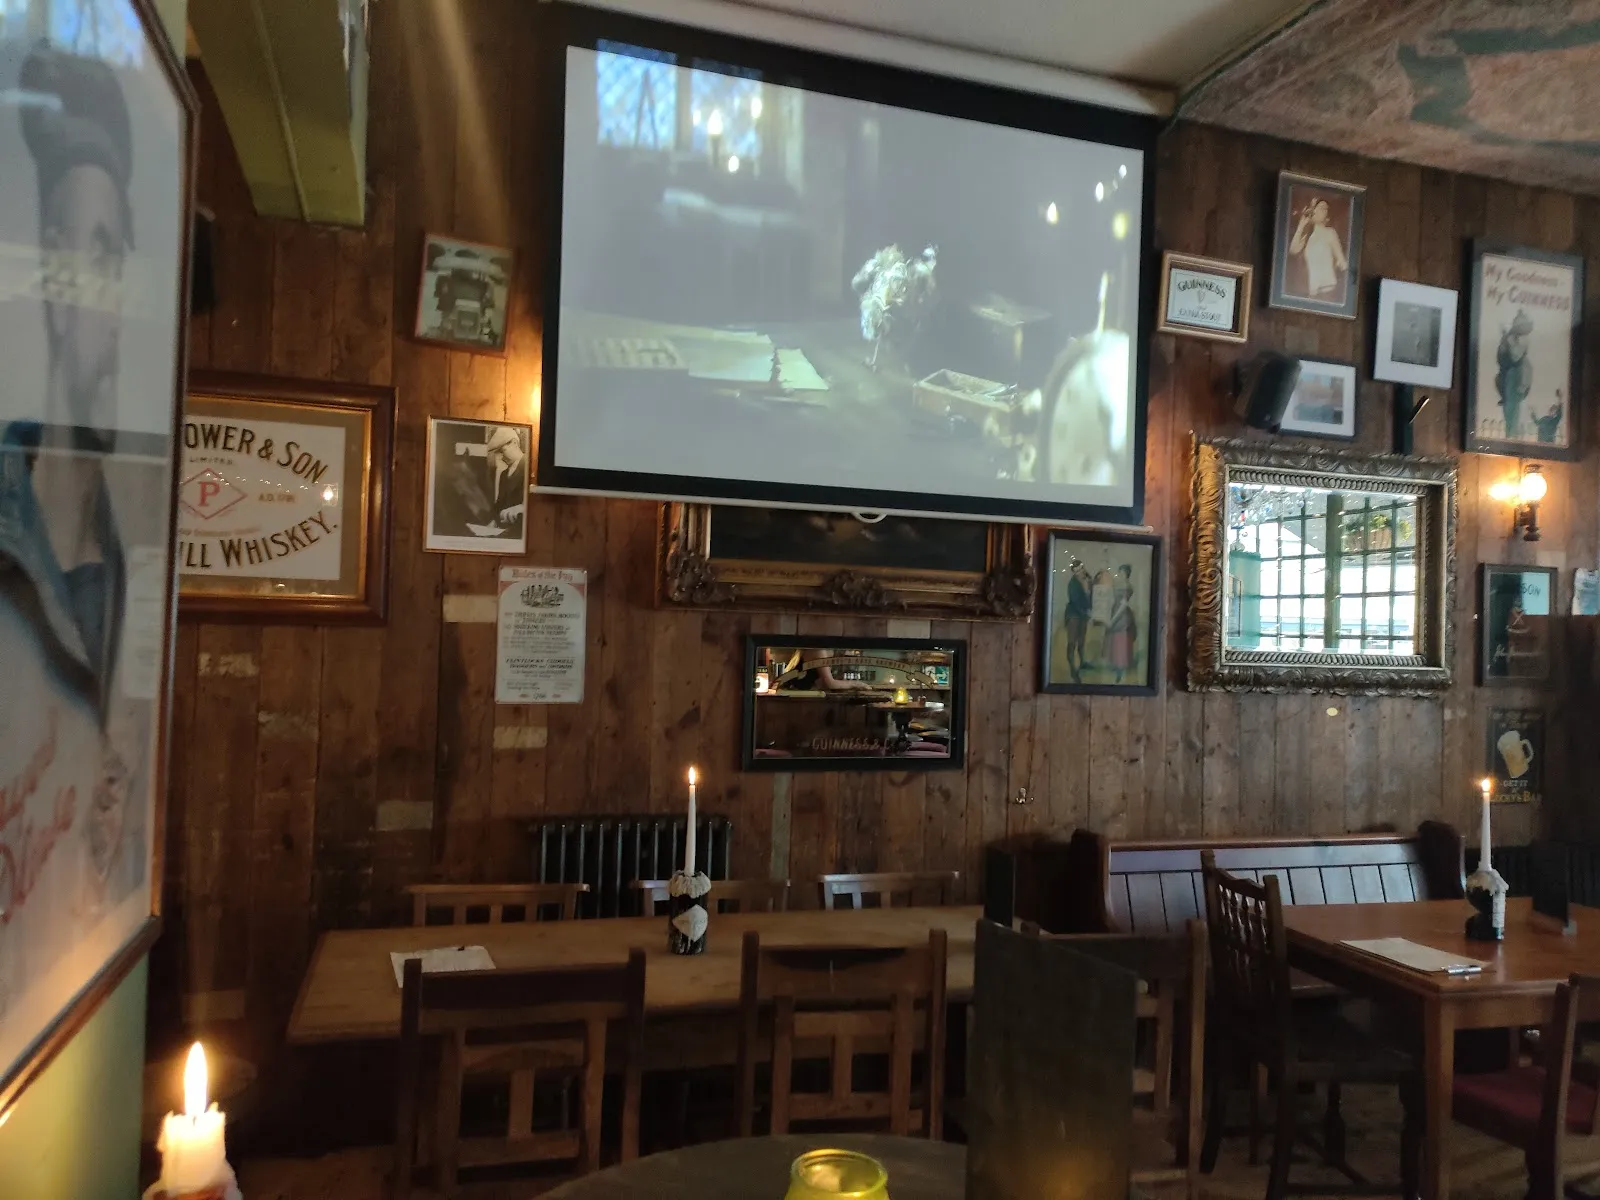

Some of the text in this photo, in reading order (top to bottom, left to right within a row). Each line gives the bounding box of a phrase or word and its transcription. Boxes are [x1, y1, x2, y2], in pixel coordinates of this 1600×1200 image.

[1177, 278, 1227, 298] GUINNESS
[1508, 285, 1571, 311] GUINNESS
[185, 422, 329, 484] OWER & SON
[198, 481, 221, 507] P
[220, 510, 339, 568] WHISKEY.
[812, 736, 869, 751] GUINNESS
